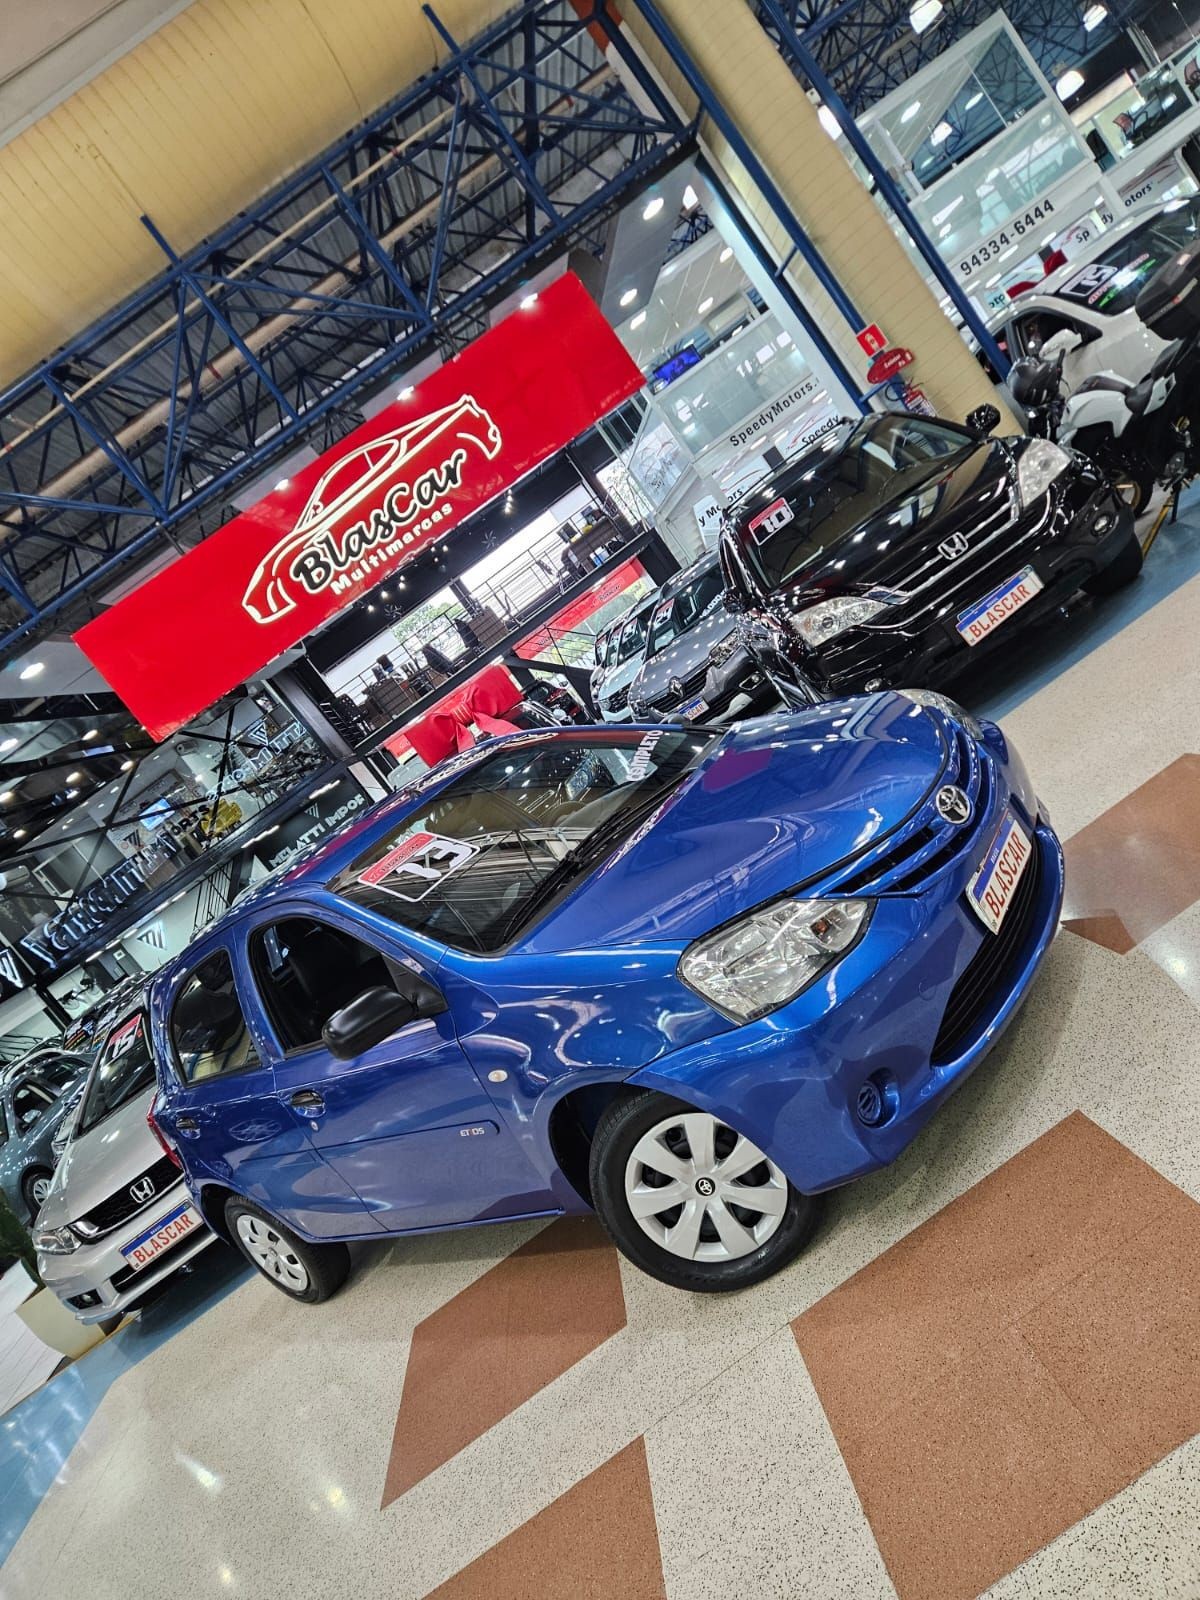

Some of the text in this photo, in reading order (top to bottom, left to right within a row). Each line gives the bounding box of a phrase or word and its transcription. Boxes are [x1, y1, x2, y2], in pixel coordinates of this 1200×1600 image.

[1124, 182, 1153, 208] otors
[960, 199, 1055, 276] 94334-6444
[729, 378, 820, 447] SpeedyMotors.
[288, 449, 467, 594] BlasCar
[760, 504, 793, 532] 10
[330, 502, 453, 595] Multimarcas
[969, 583, 1030, 637] BLASCAR
[268, 822, 326, 868] MELATTI
[395, 840, 473, 876] 13
[984, 831, 1027, 918] BLASCAR
[112, 1025, 135, 1058] 15
[133, 1213, 193, 1263] BLASCAR
